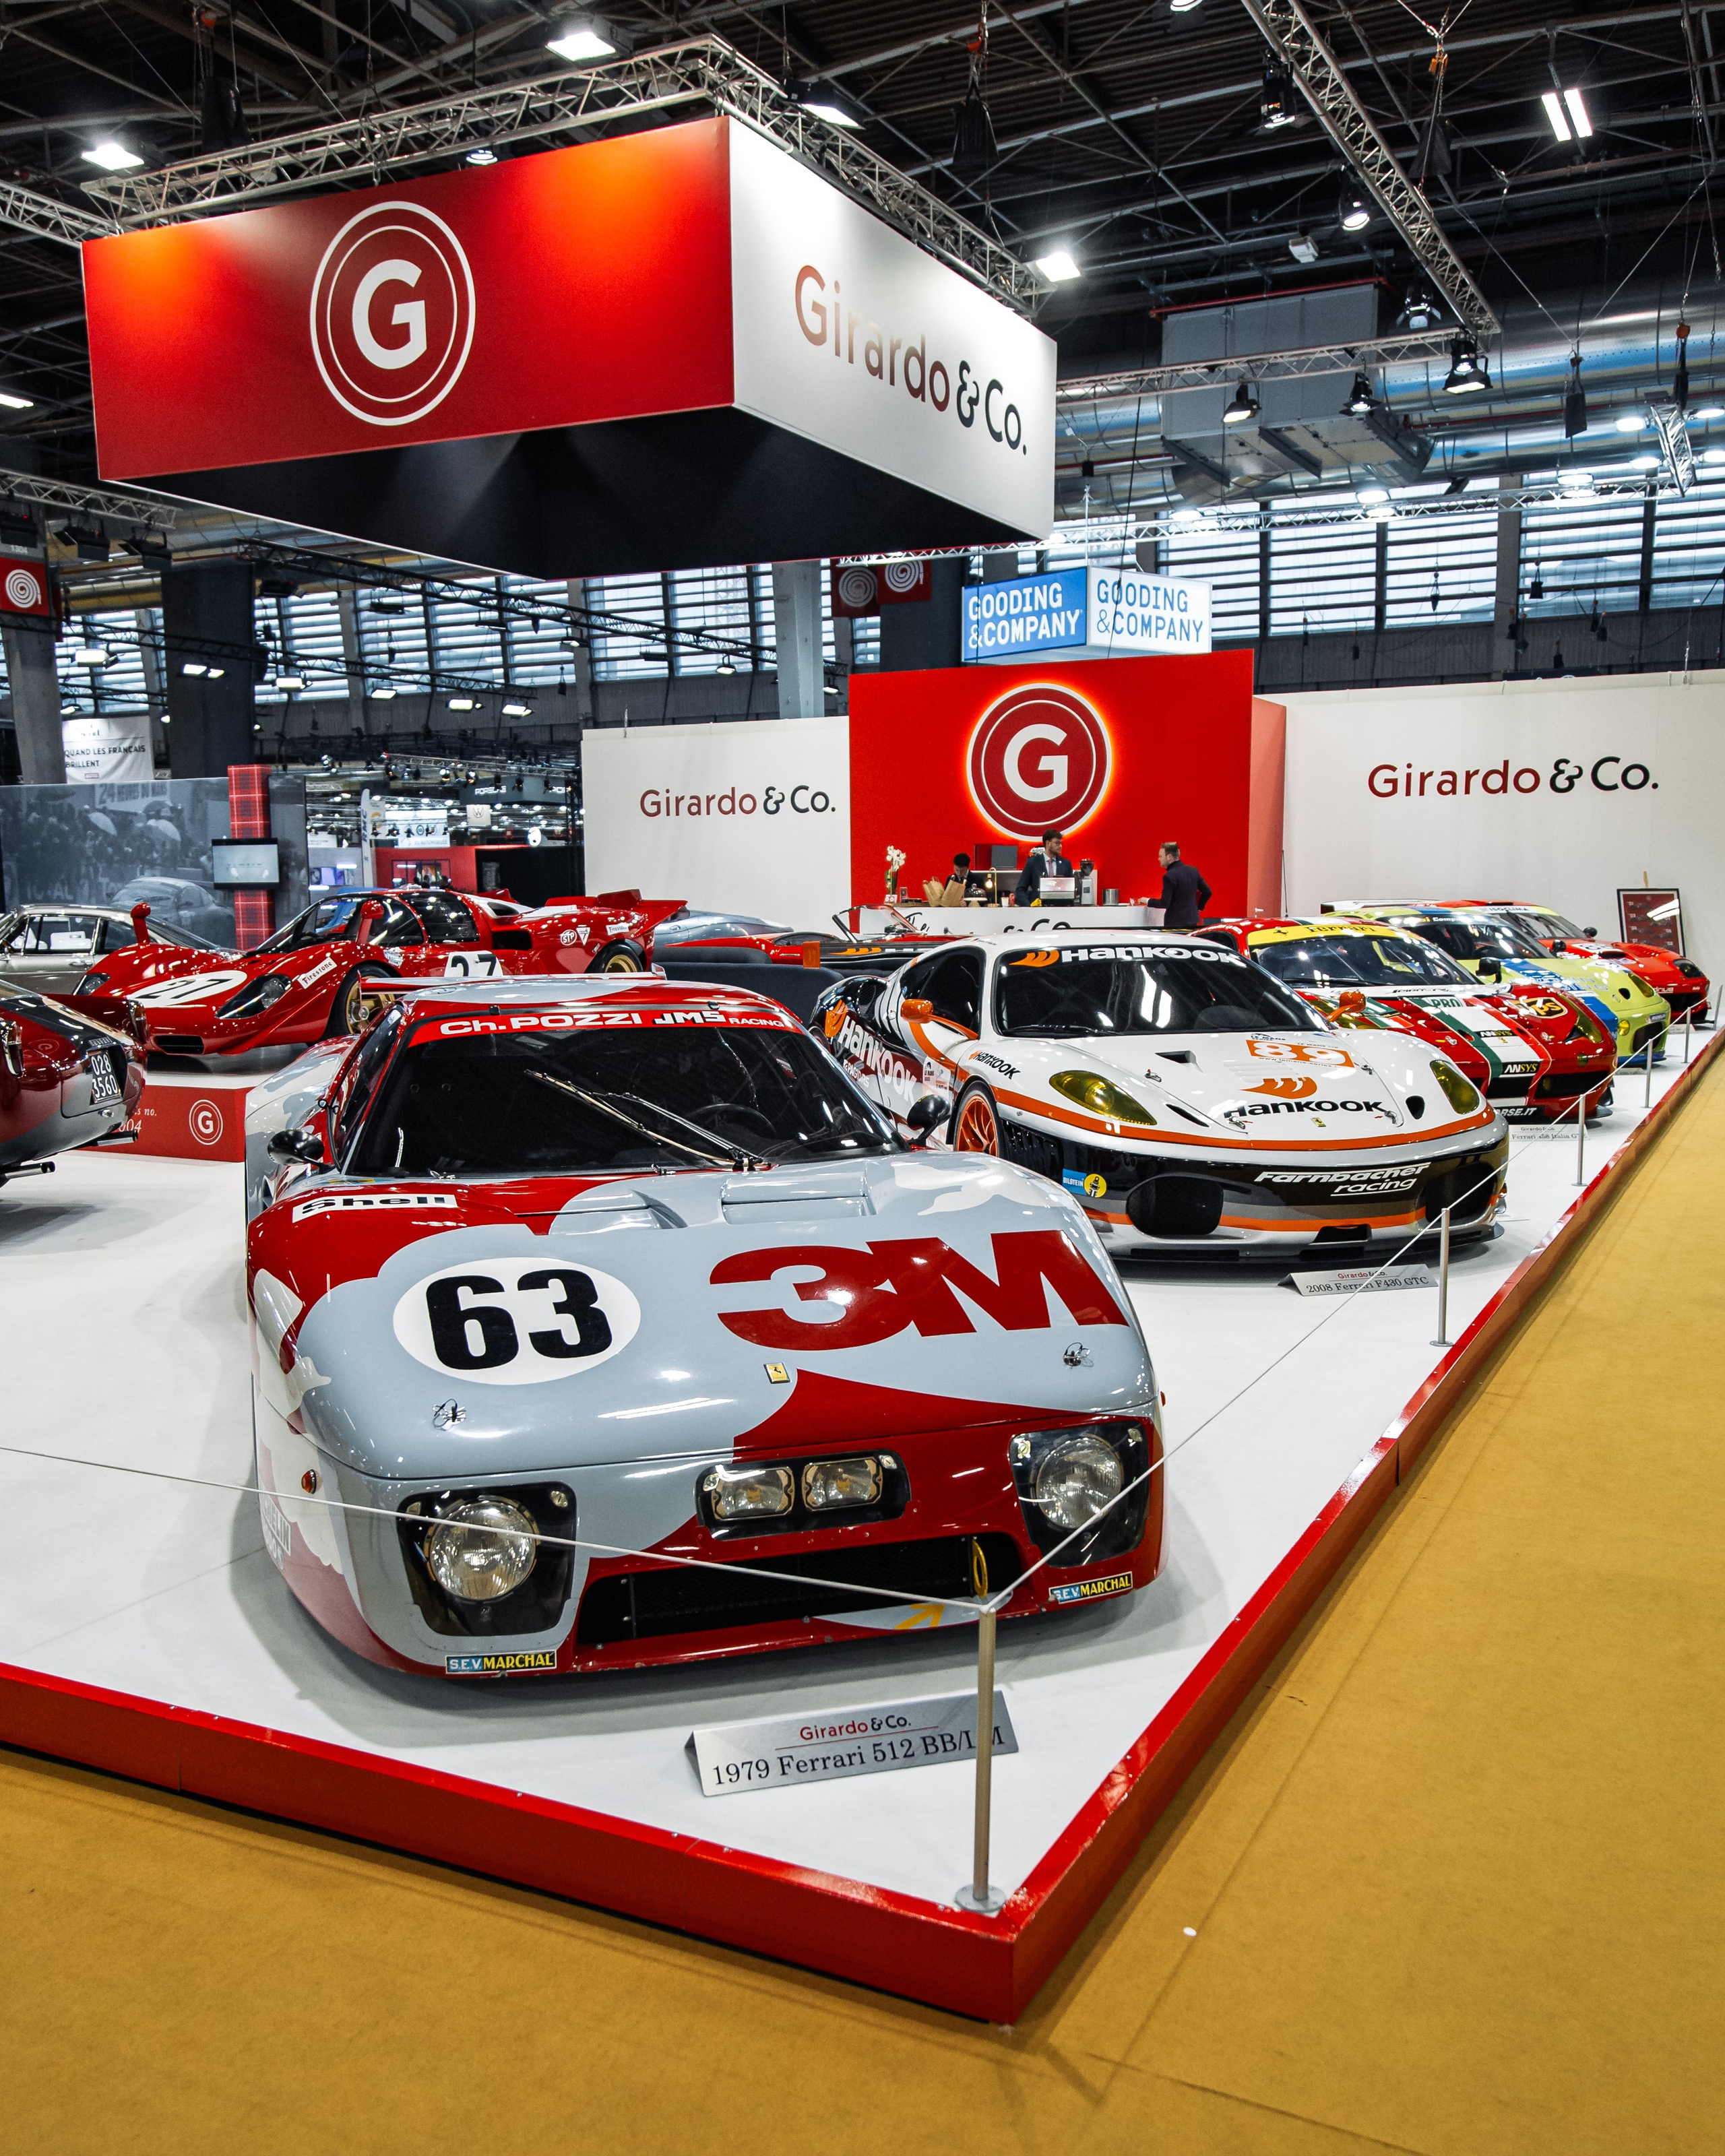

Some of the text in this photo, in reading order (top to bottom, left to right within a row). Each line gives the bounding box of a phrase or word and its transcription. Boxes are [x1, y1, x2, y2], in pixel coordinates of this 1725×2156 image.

[968, 582, 1063, 621] GOODING
[1098, 579, 1188, 613] GOODING
[94, 747, 106, 755] LES
[562, 932, 575, 944] STP
[302, 961, 333, 986] Firestone
[134, 978, 234, 999] 27
[511, 1013, 642, 1030] POZZI
[728, 1016, 785, 1028] RACING
[1253, 1042, 1346, 1065] 89
[91, 1054, 112, 1076] 028
[1504, 1063, 1538, 1073] ANSYS
[92, 1074, 119, 1099] 3560
[144, 1108, 158, 1116] no.
[1063, 1176, 1084, 1188] BILSTEIN
[1253, 1163, 1431, 1183] Farnbacher
[1333, 1178, 1418, 1193] racing
[301, 1196, 447, 1211] Shell
[709, 1229, 1130, 1352] 3M
[1306, 1276, 1429, 1294] 2008 Ferrari F430 GTC
[425, 1268, 613, 1371] 63
[1079, 1575, 1131, 1597] MARCHAL
[482, 1653, 554, 1670] MARCHAL
[712, 1758, 771, 1785] 1979
[777, 1748, 866, 1777] Ferrari
[872, 1738, 916, 1763] 512
